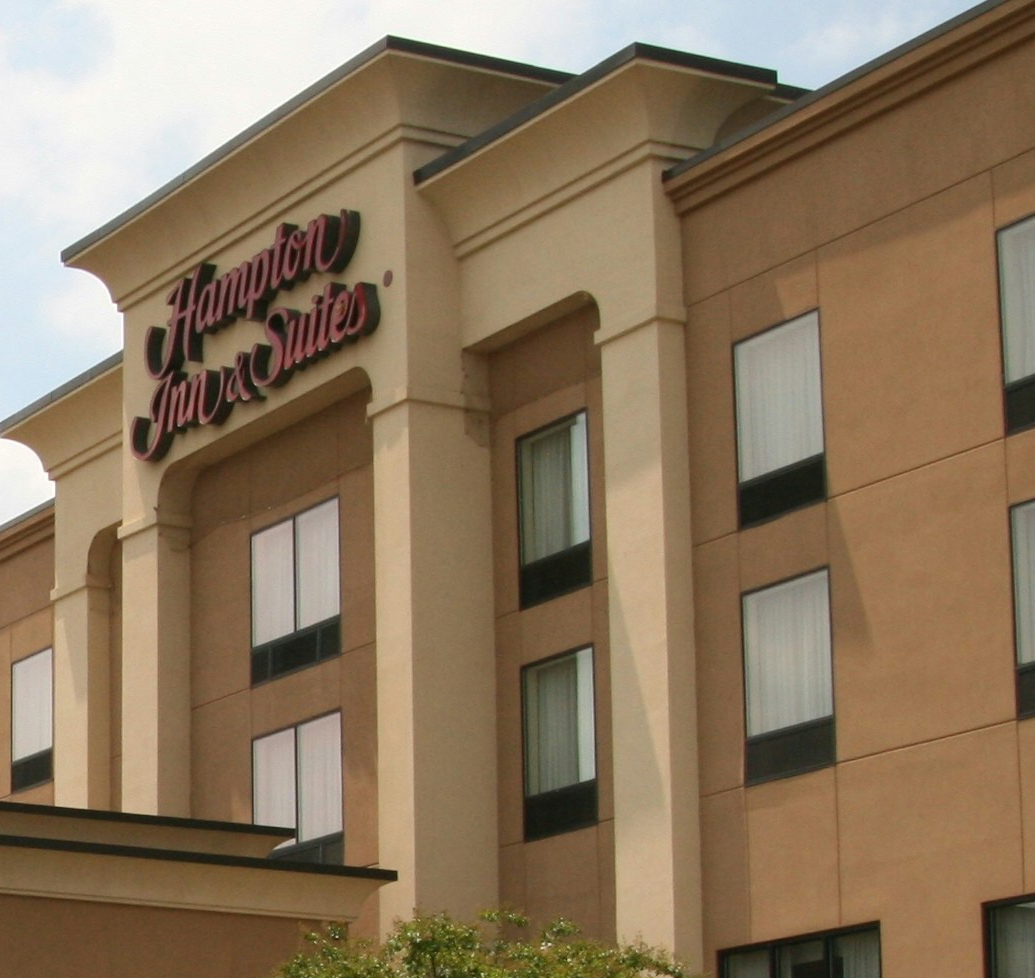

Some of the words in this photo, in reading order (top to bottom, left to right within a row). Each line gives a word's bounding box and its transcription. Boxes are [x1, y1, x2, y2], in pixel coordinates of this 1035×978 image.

[130, 365, 234, 461] Inn
[225, 351, 266, 402] &
[249, 281, 381, 388] Suites
[144, 208, 360, 380] Hampton
